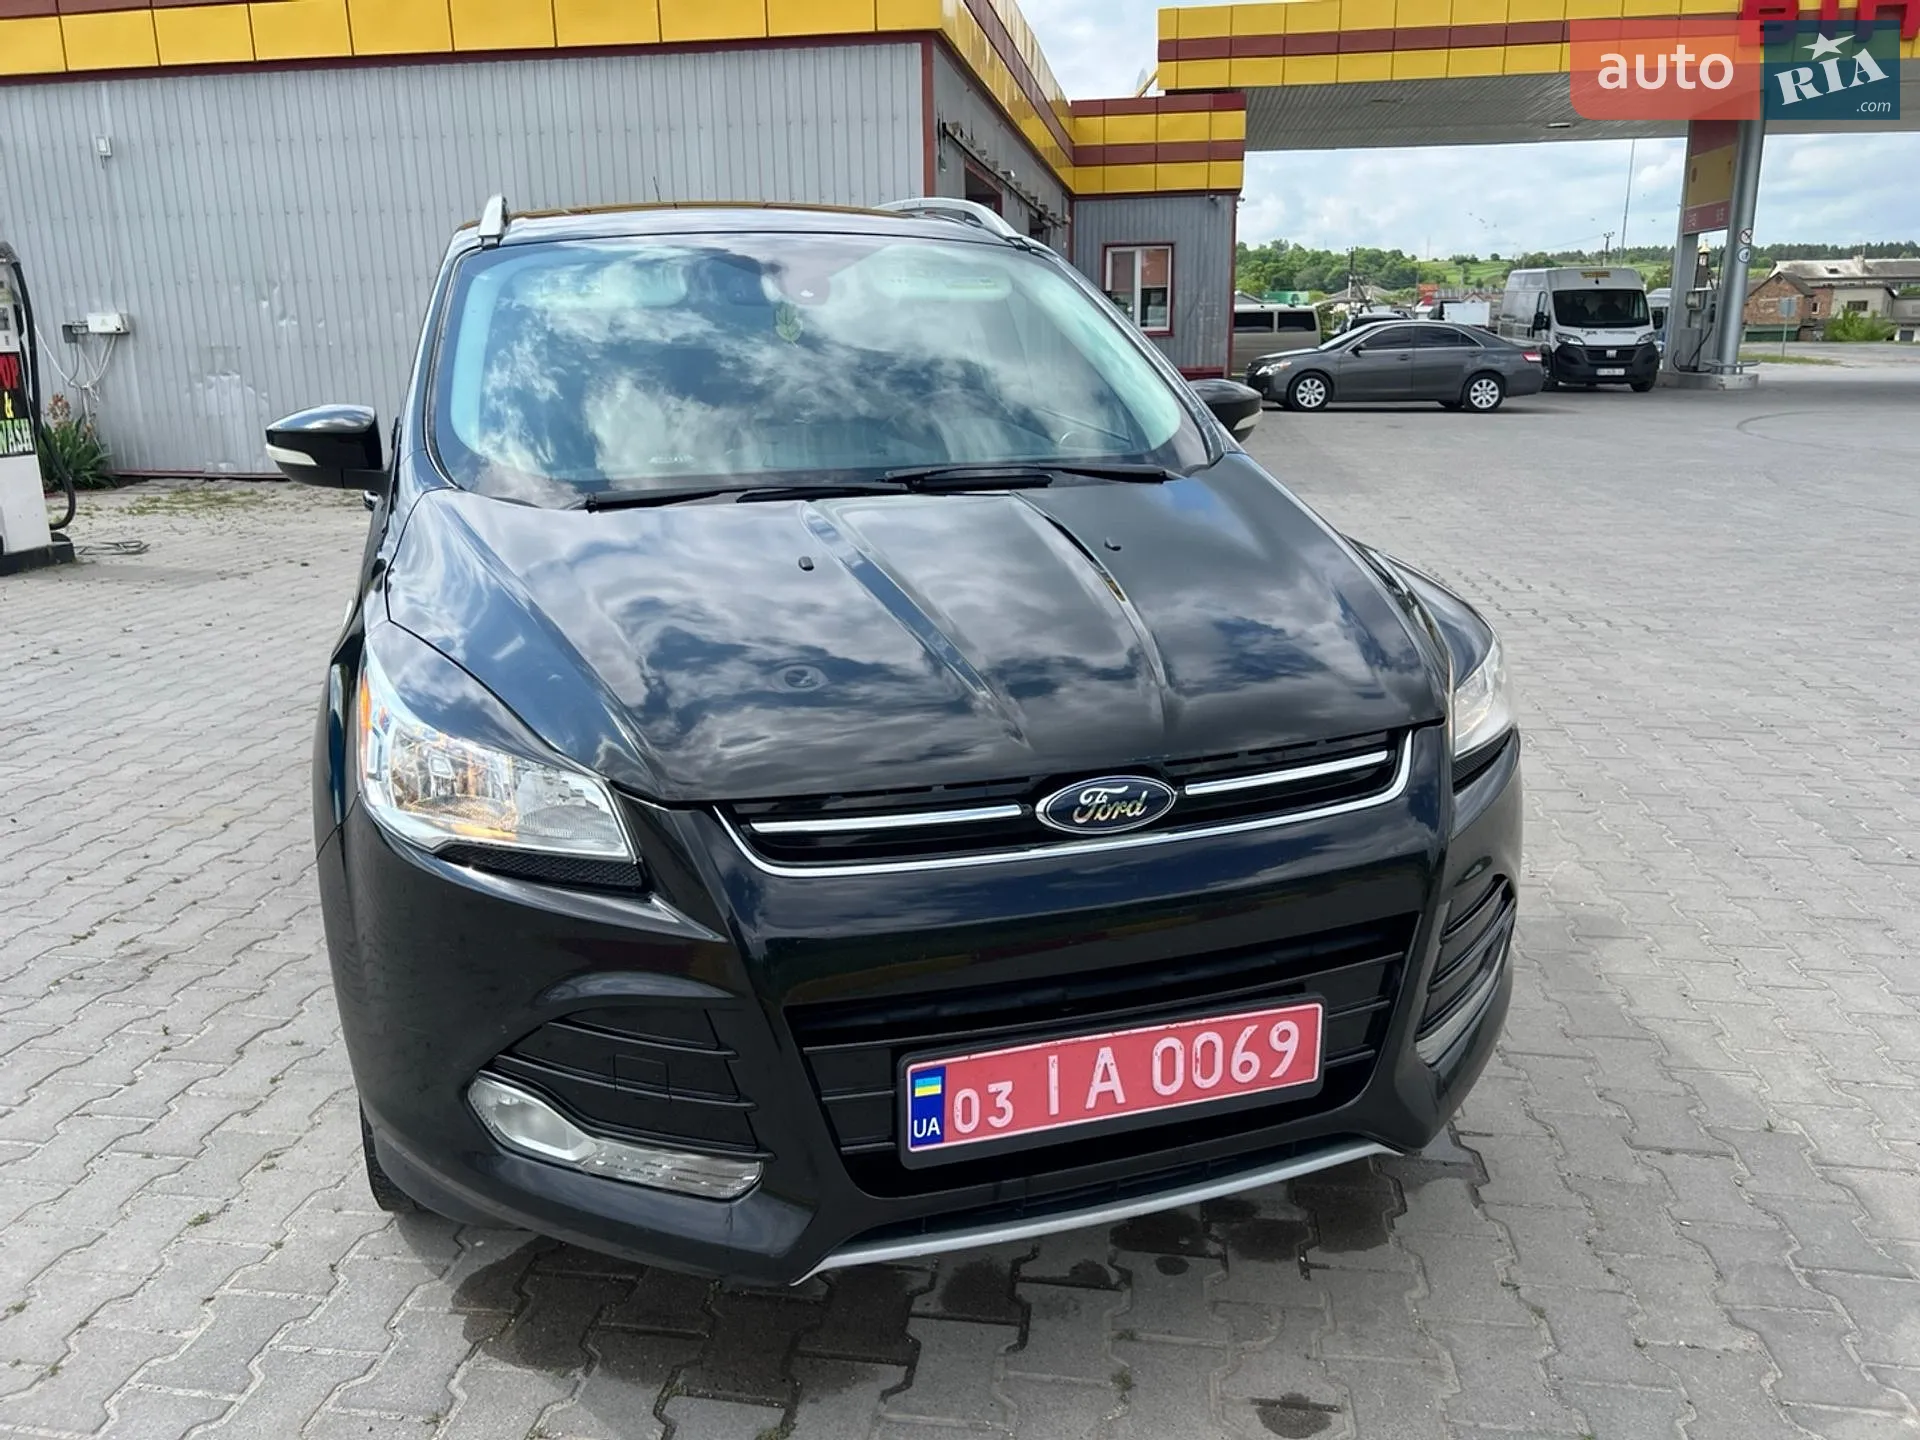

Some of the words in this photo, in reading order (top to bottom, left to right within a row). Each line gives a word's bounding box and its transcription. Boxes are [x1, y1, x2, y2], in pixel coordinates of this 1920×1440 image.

[1073, 785, 1149, 824] Ford
[952, 1080, 1015, 1135] 03
[1150, 1019, 1300, 1097] 0069
[912, 1117, 941, 1139] UA
